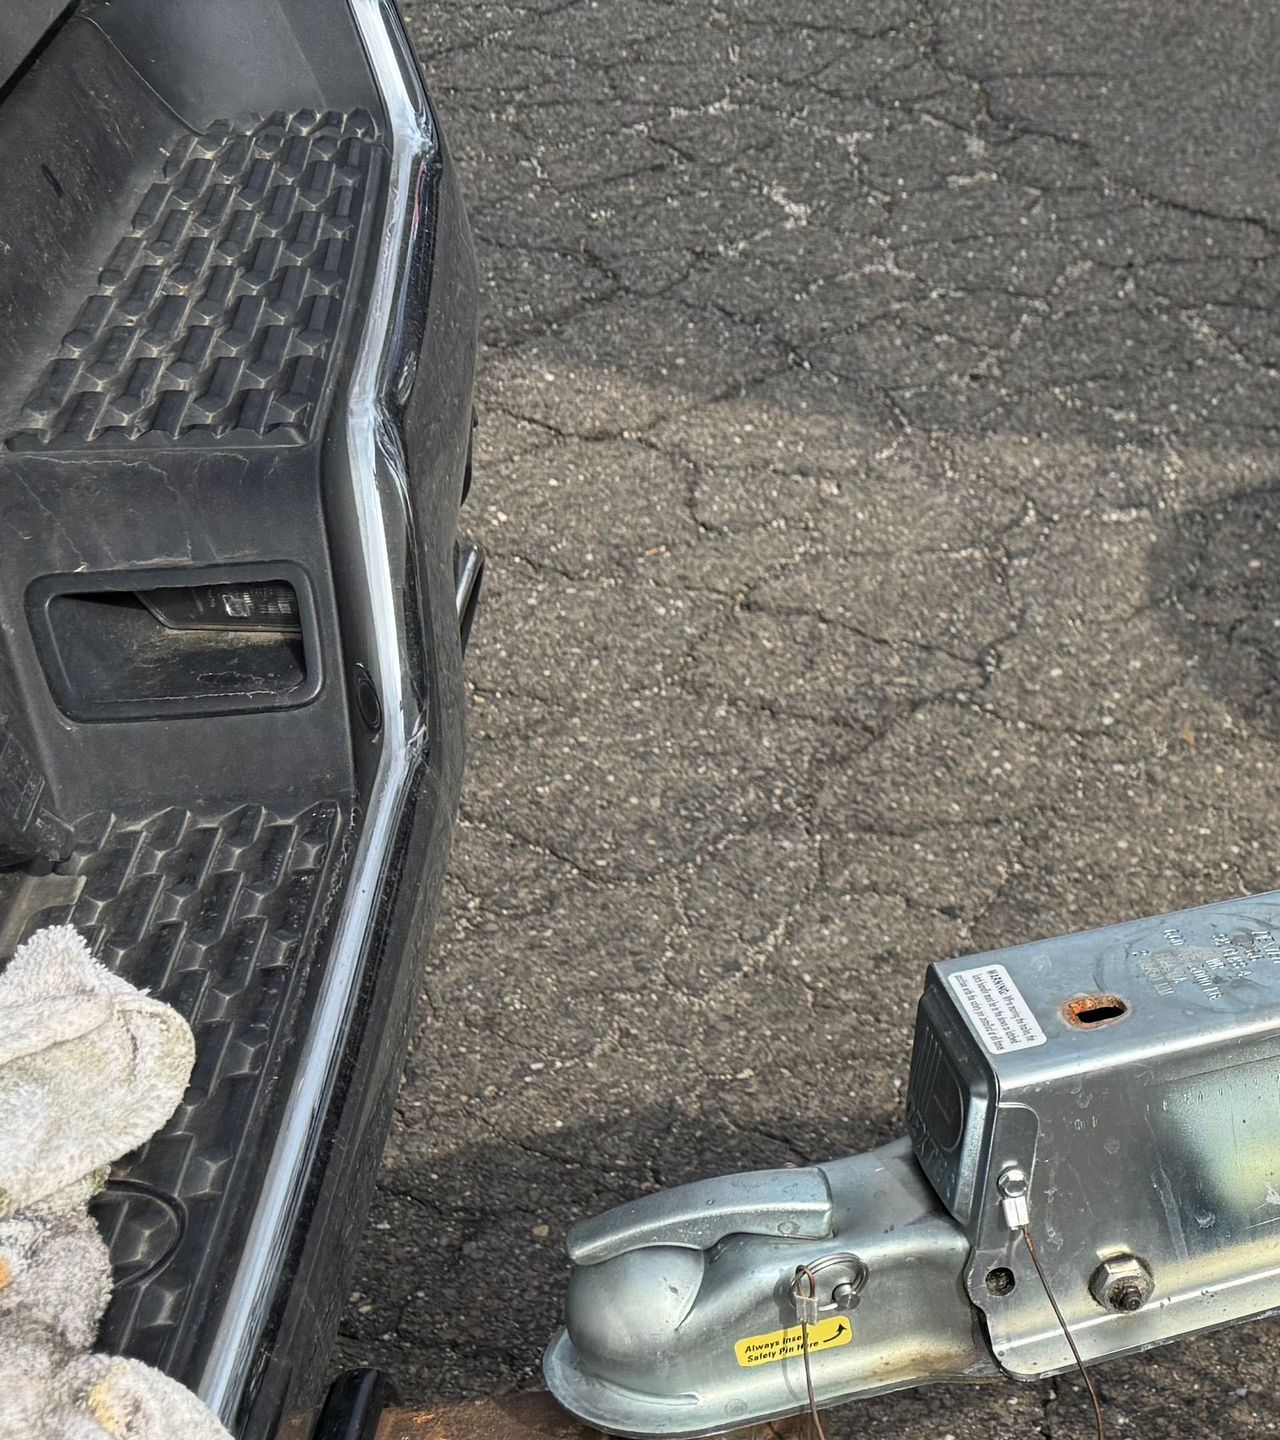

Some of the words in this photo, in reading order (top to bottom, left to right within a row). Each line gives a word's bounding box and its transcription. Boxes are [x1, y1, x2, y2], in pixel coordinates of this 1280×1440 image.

[745, 1340, 780, 1354] Always
[782, 1333, 809, 1345] Inse
[747, 1350, 776, 1363] Safety
[779, 1347, 794, 1355] Pin
[797, 1341, 819, 1351] Hre
